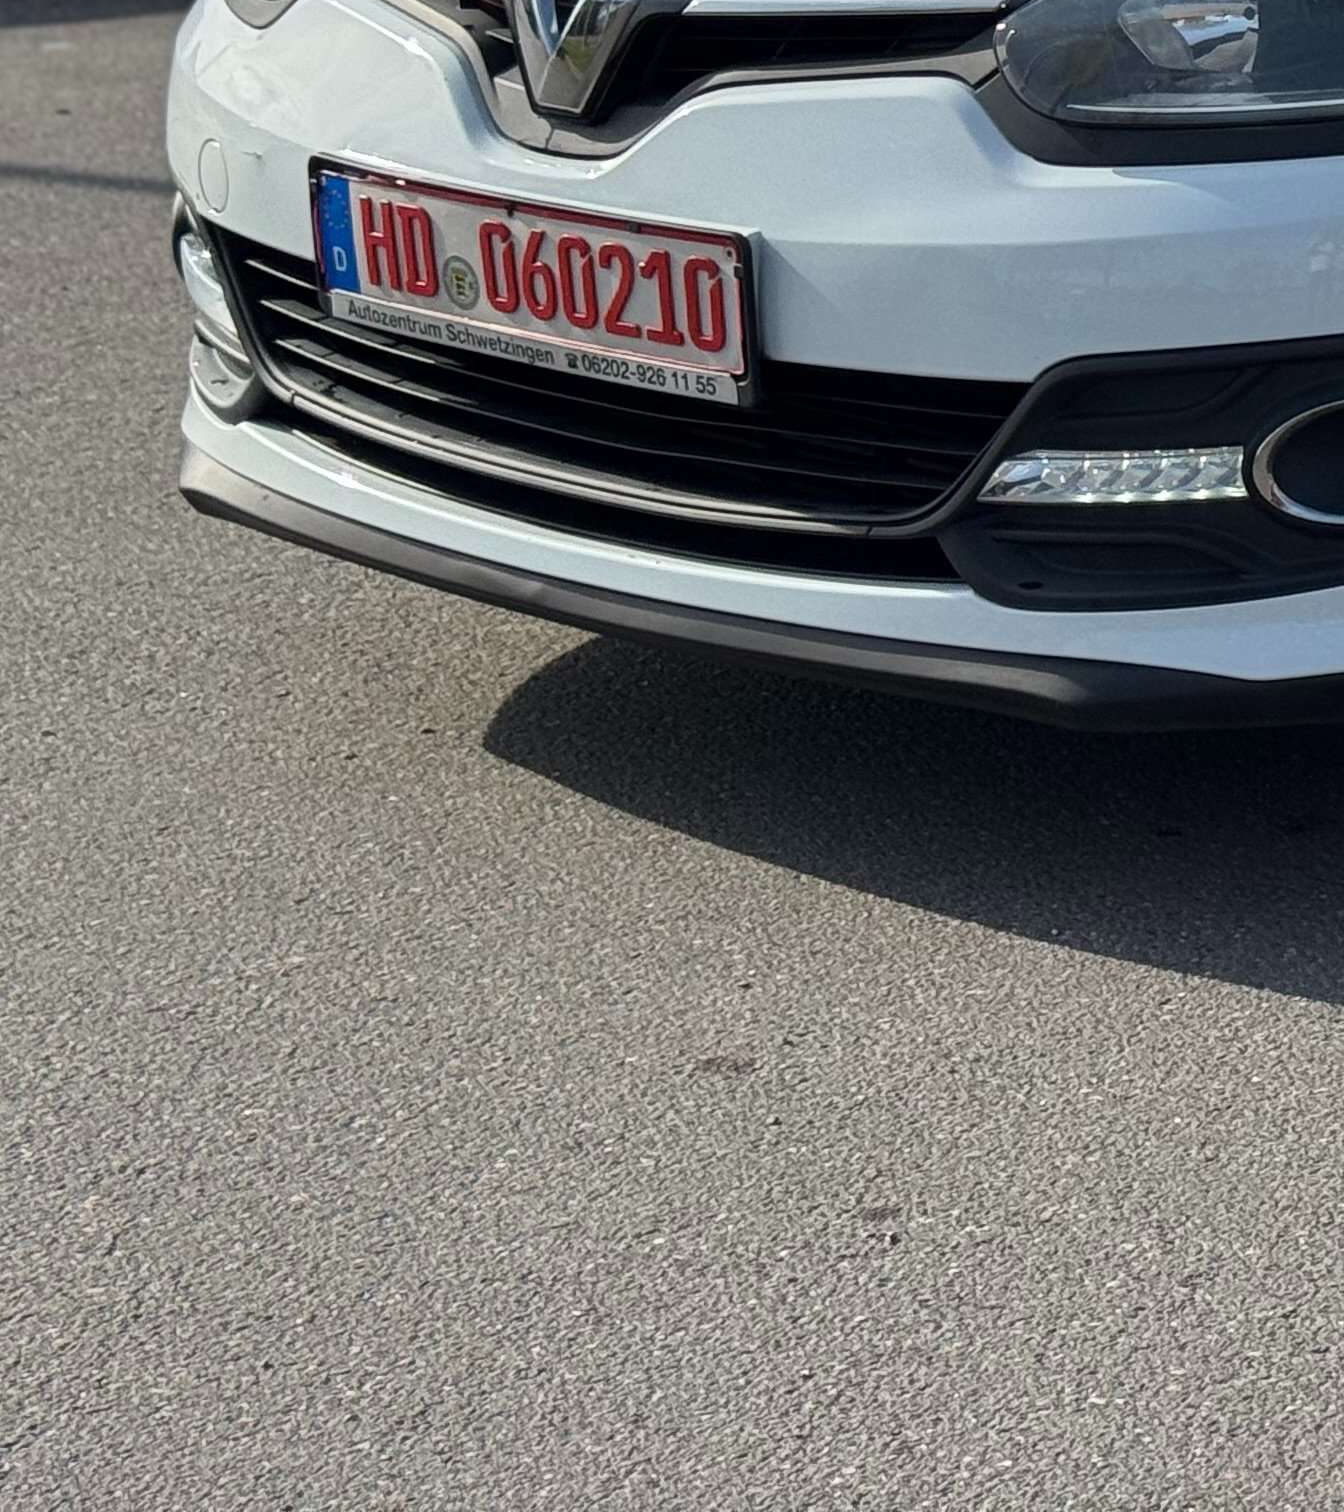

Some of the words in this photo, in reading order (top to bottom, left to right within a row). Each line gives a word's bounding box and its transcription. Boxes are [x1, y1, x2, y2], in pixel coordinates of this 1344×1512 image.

[332, 246, 348, 272] D
[359, 194, 439, 297] HD
[479, 219, 726, 353] 060210
[348, 299, 443, 340] Autozentrum
[446, 324, 556, 367] Schwetzingen
[581, 354, 667, 387] 06202-926
[671, 371, 690, 391] 11
[696, 375, 717, 396] 55
